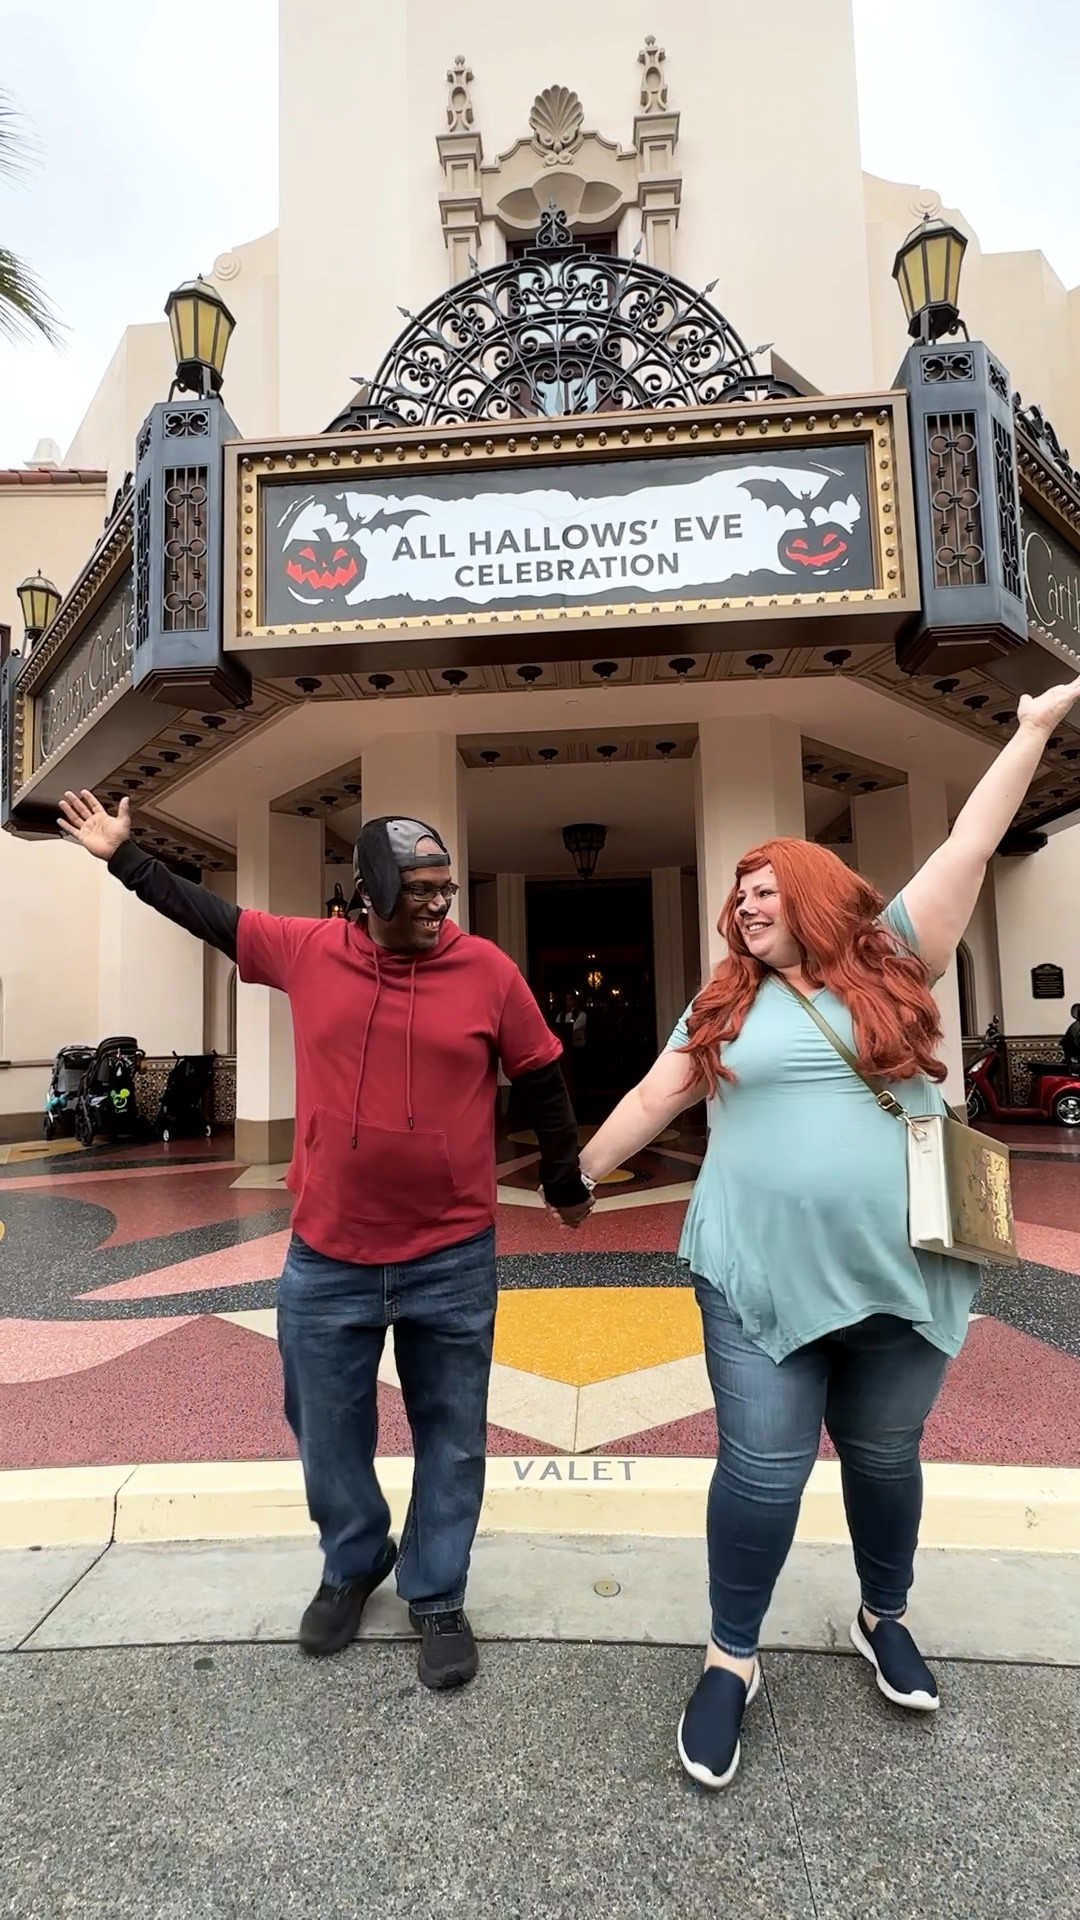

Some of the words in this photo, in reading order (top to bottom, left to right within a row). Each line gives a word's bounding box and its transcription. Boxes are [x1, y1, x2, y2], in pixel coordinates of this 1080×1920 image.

[392, 534, 456, 561] ALL
[674, 513, 743, 543] EVE
[454, 552, 679, 587] CELEBRATION
[513, 1460, 637, 1481] VALET
